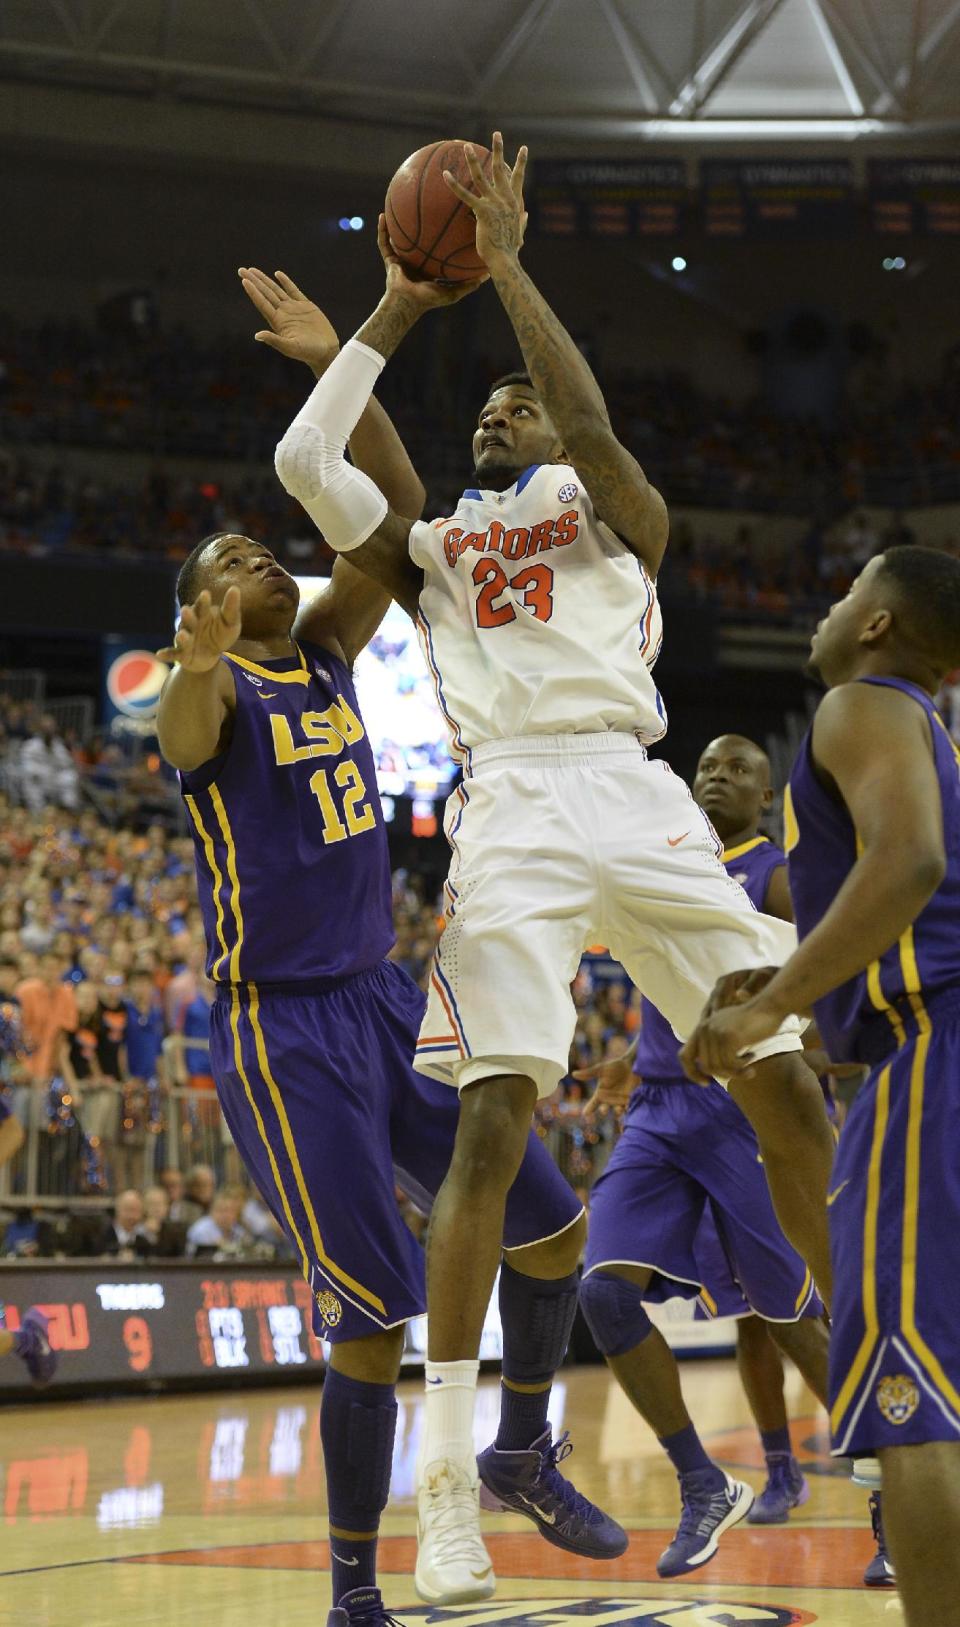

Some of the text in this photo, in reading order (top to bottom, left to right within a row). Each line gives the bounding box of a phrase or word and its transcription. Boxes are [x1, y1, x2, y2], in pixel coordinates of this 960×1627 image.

[558, 483, 578, 503] SEC
[443, 509, 579, 568] GATORS
[471, 557, 554, 629] 23
[269, 694, 365, 766] LSU
[309, 759, 377, 845] 12
[123, 1315, 153, 1373] 9
